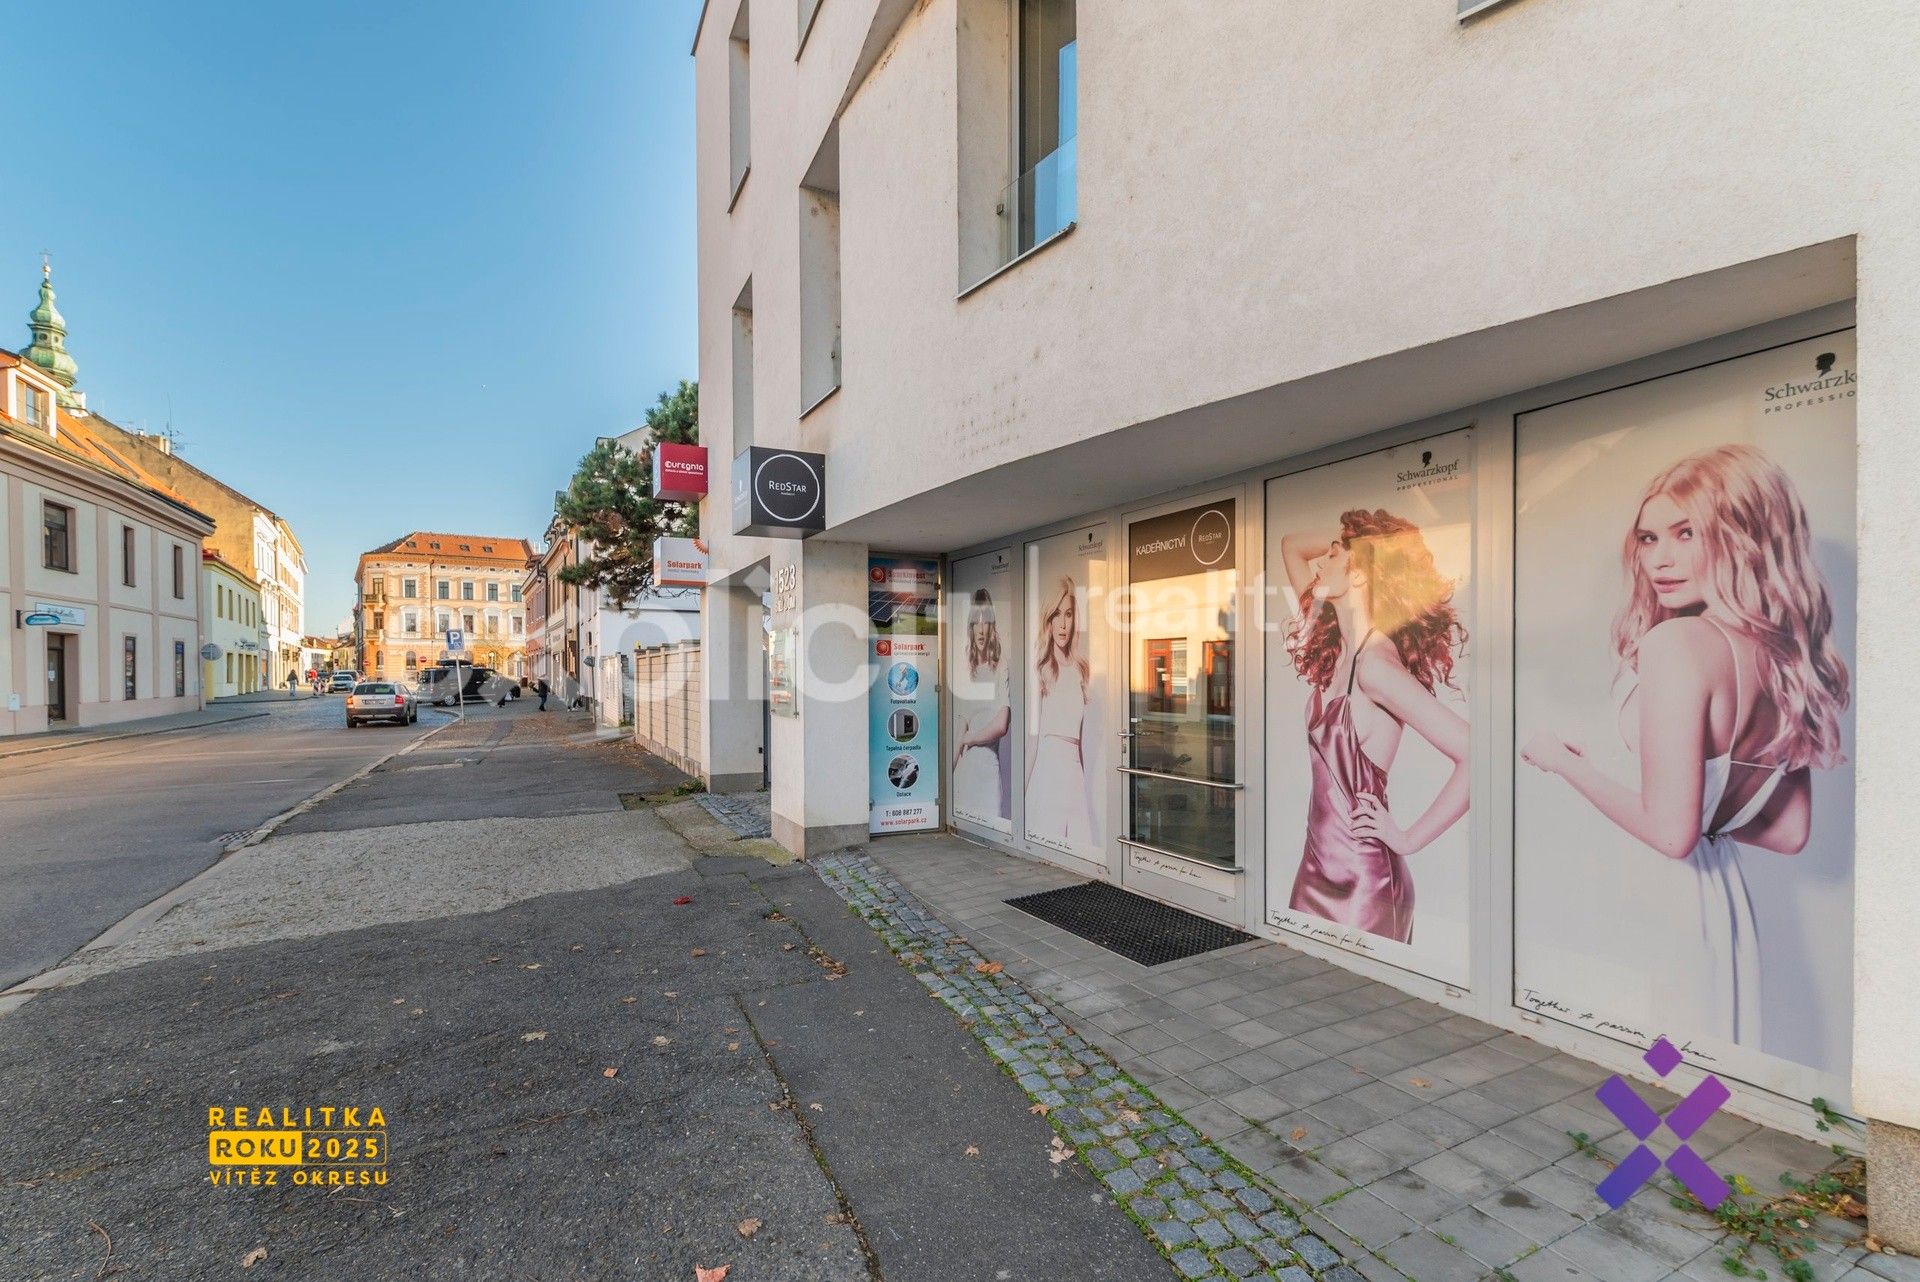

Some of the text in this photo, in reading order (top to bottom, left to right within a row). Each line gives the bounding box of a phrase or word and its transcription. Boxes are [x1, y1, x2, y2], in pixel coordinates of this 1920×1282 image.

[1765, 369, 1857, 401] Schwarzk
[1397, 459, 1459, 482] Schwarzkopf
[1397, 475, 1458, 491] PROFESSIONAL
[1135, 534, 1186, 556] KADEŘNICTVÍ
[667, 560, 703, 570] Solarpark
[775, 563, 797, 595] 1523
[449, 631, 460, 645] P
[894, 643, 925, 652] Solarpark
[880, 817, 927, 826] www.solarpark.cz
